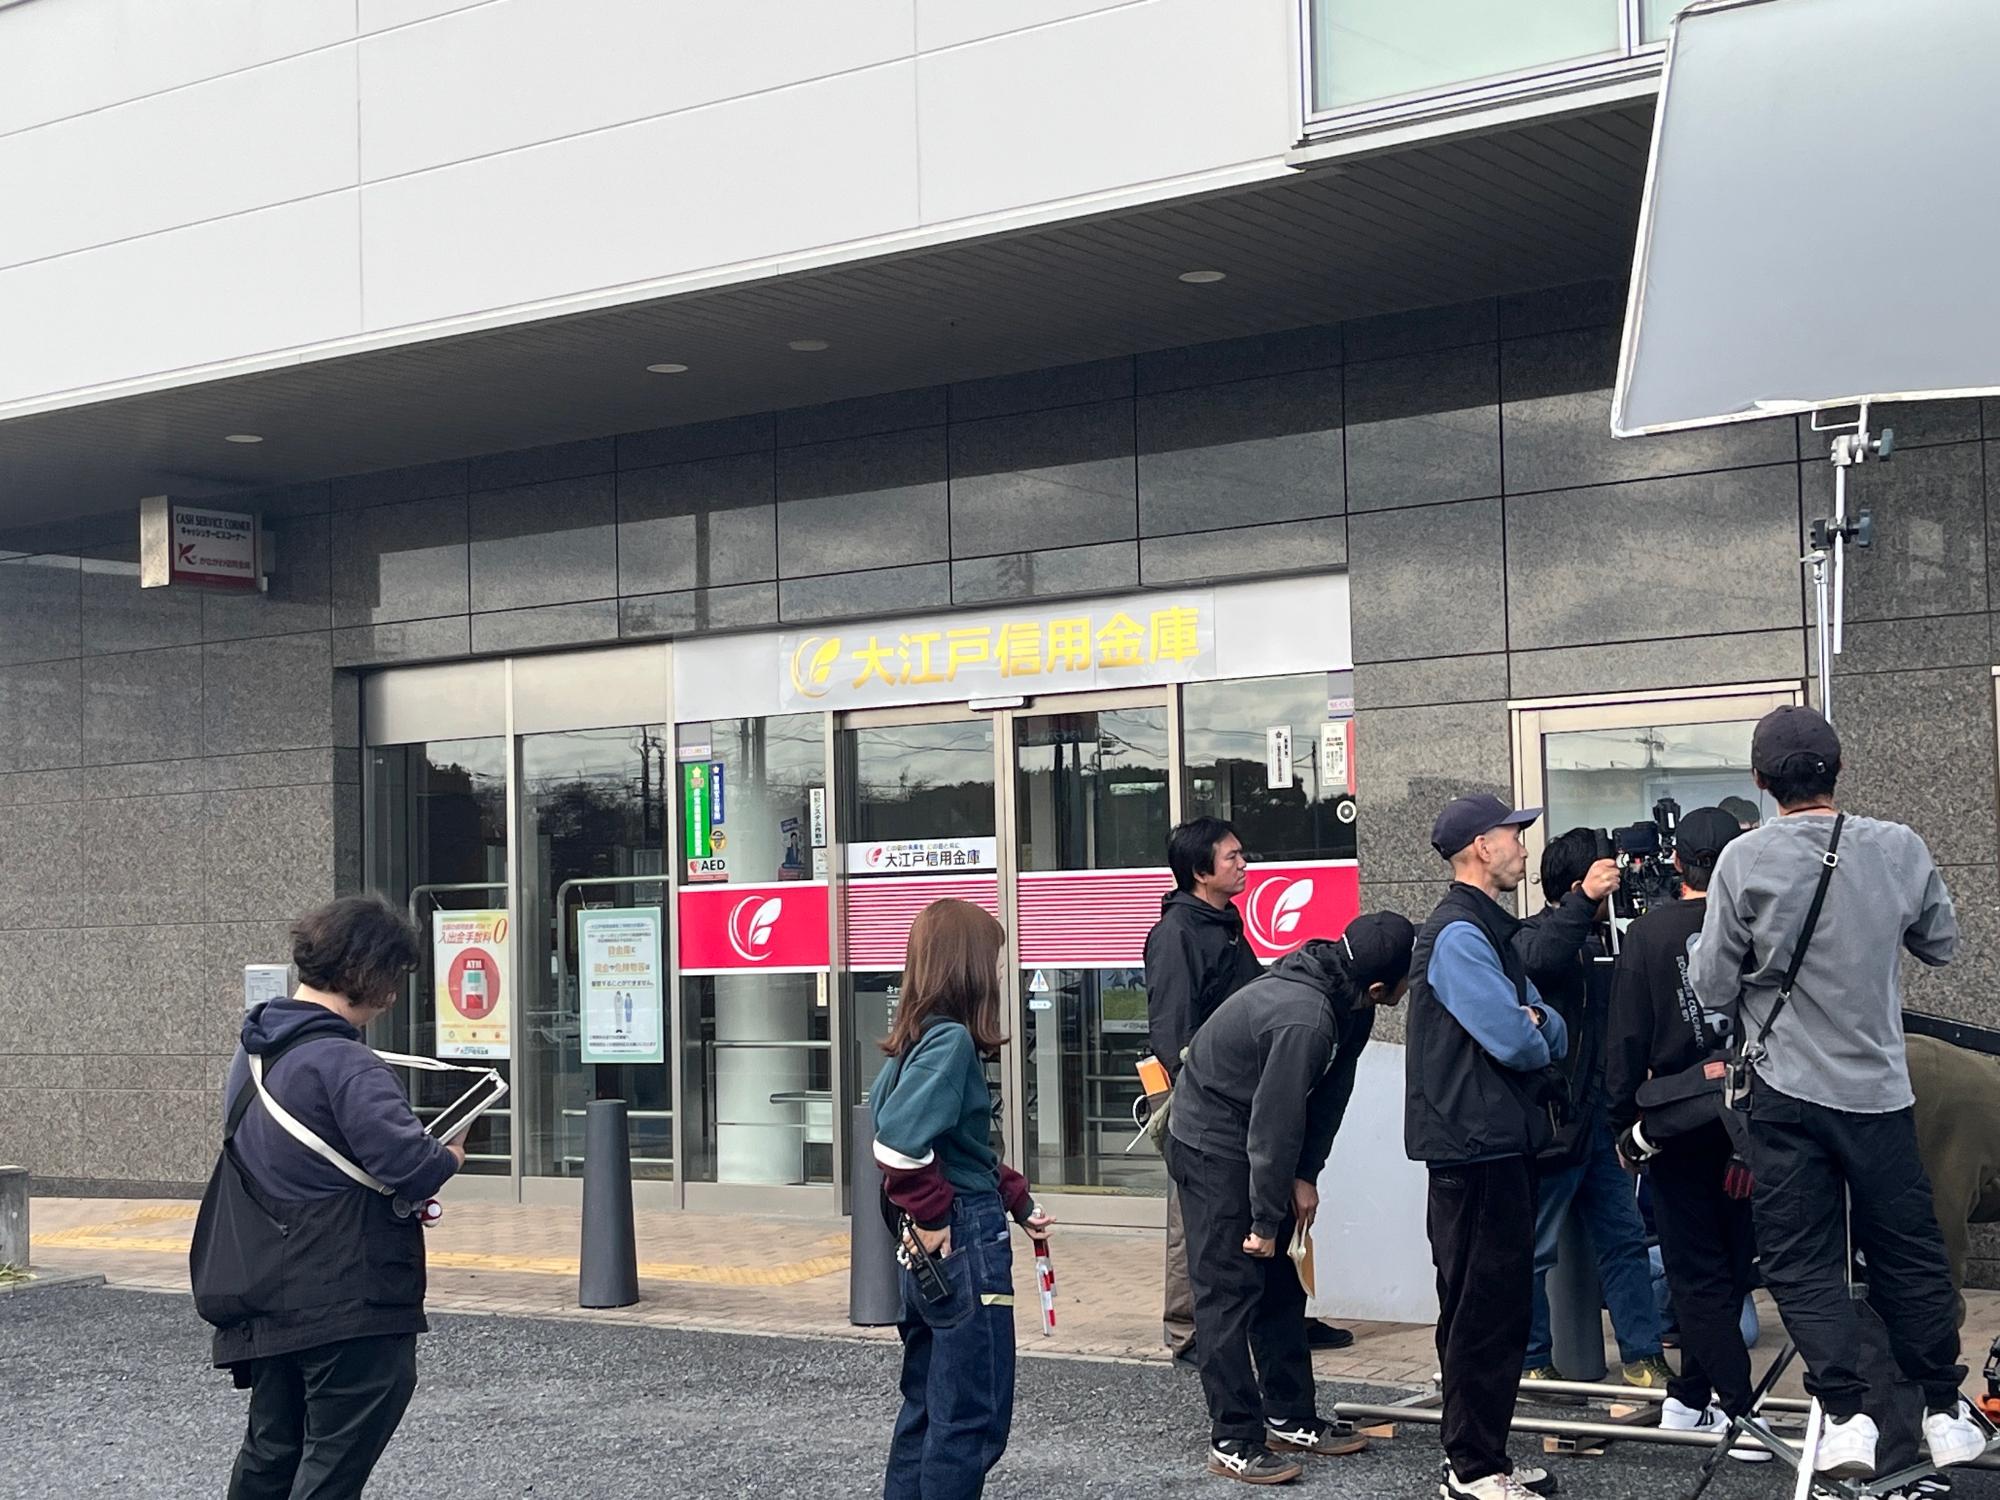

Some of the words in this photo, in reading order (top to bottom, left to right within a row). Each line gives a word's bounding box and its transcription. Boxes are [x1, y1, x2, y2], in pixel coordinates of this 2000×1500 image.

[176, 513, 195, 525] CASH
[196, 516, 223, 528] SERVICE
[224, 518, 251, 530] CORNER
[852, 606, 1200, 689] 大江戸信用金庫
[701, 859, 725, 872] AED
[885, 849, 980, 868] 大江戸信用金庫
[438, 931, 491, 944] 入出金手数料
[493, 918, 508, 944] 0
[1676, 955, 1694, 999] BOULDER
[1687, 999, 1704, 1049] COLORADO
